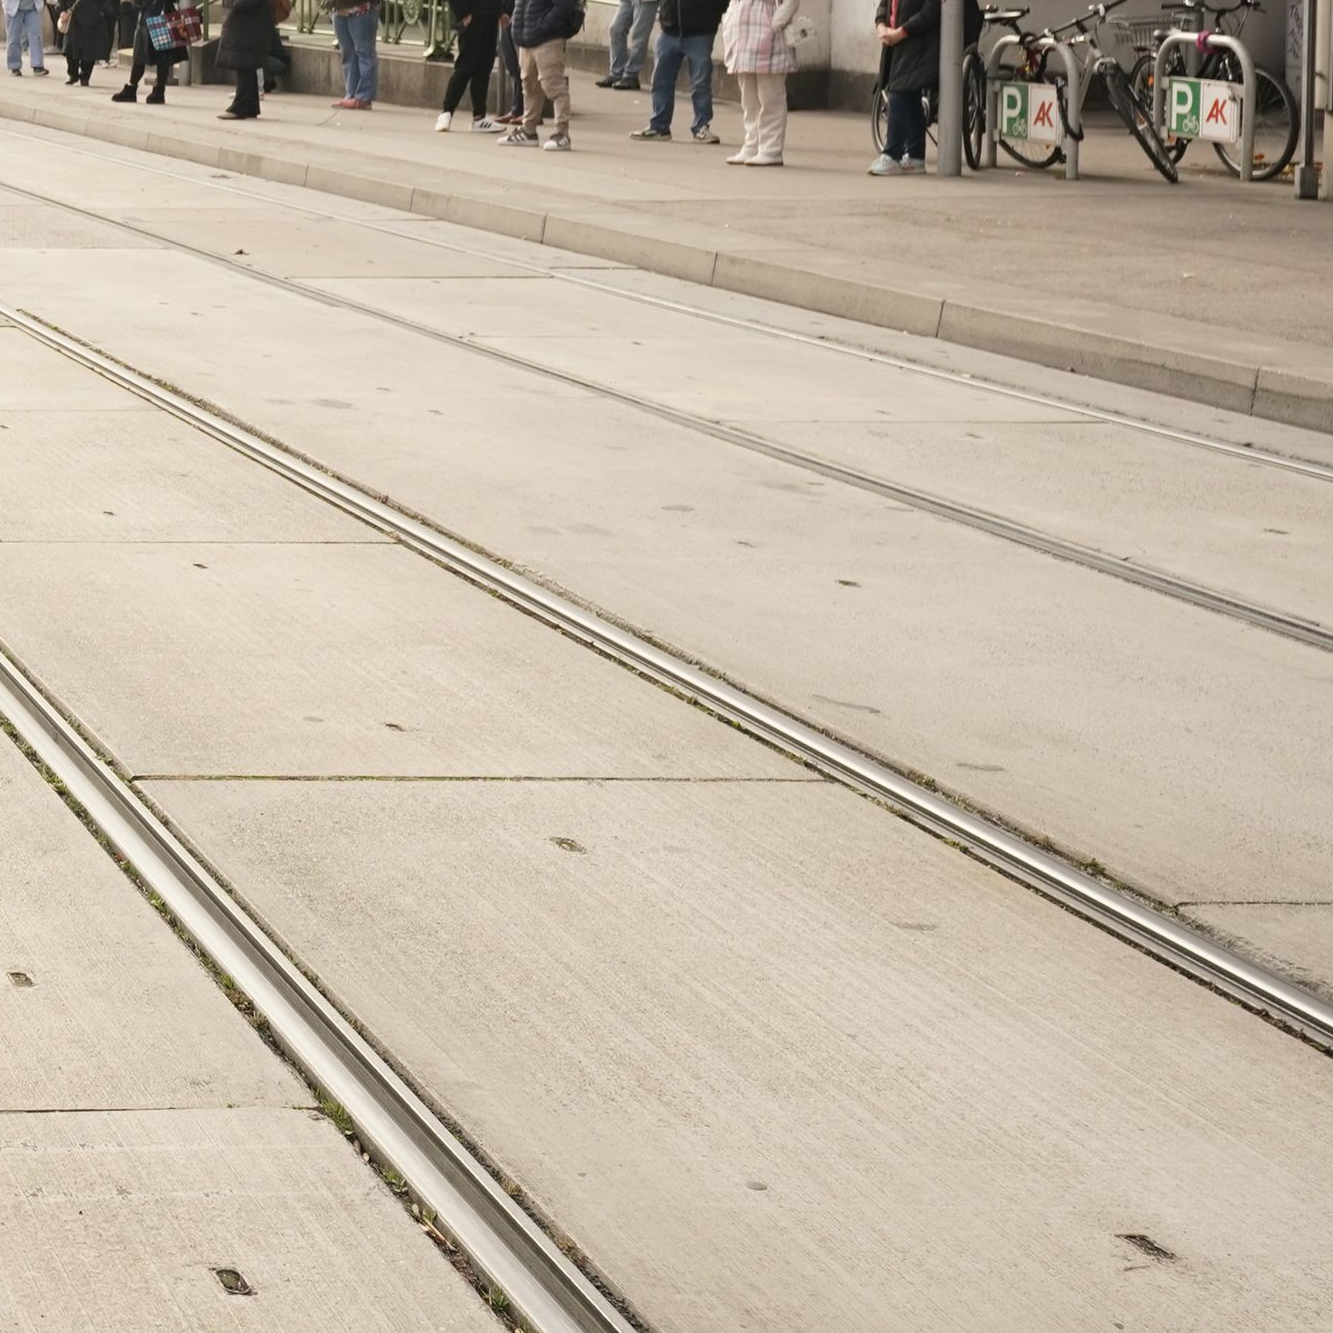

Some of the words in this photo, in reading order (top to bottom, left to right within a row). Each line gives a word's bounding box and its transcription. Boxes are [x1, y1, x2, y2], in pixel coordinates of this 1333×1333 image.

[1002, 86, 1022, 134] P
[1033, 101, 1053, 128] AK
[1171, 82, 1193, 131] P
[1206, 98, 1227, 125] AK
